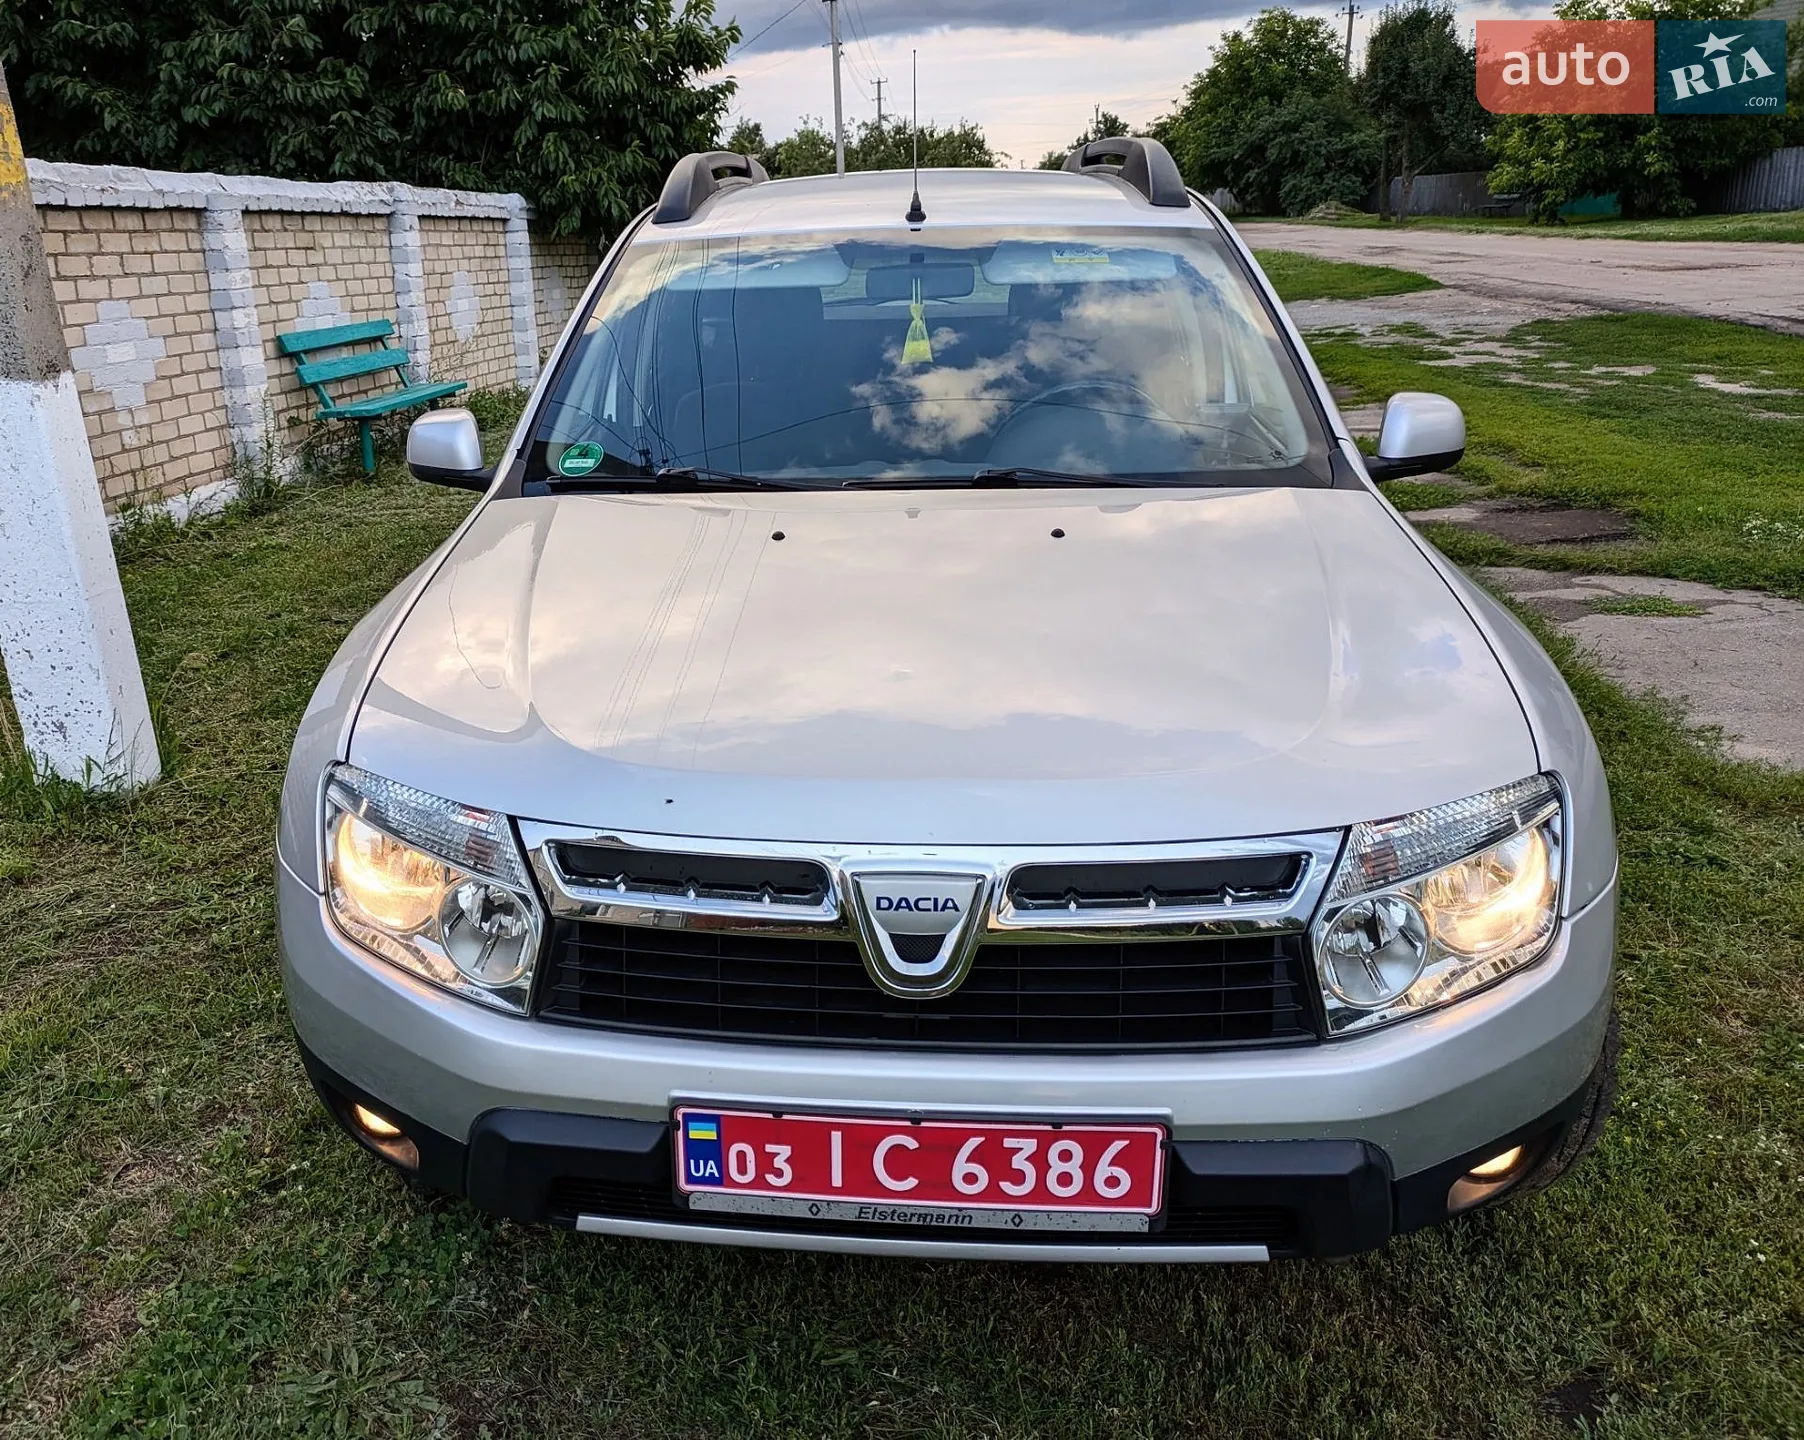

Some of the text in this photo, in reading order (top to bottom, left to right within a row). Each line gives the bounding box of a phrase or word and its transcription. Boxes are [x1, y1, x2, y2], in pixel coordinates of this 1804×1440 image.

[876, 896, 960, 912] DACIA
[689, 1159, 719, 1178] UA
[728, 1143, 793, 1187] 03
[951, 1137, 1132, 1199] 6386
[857, 1206, 974, 1225] Elstermann
